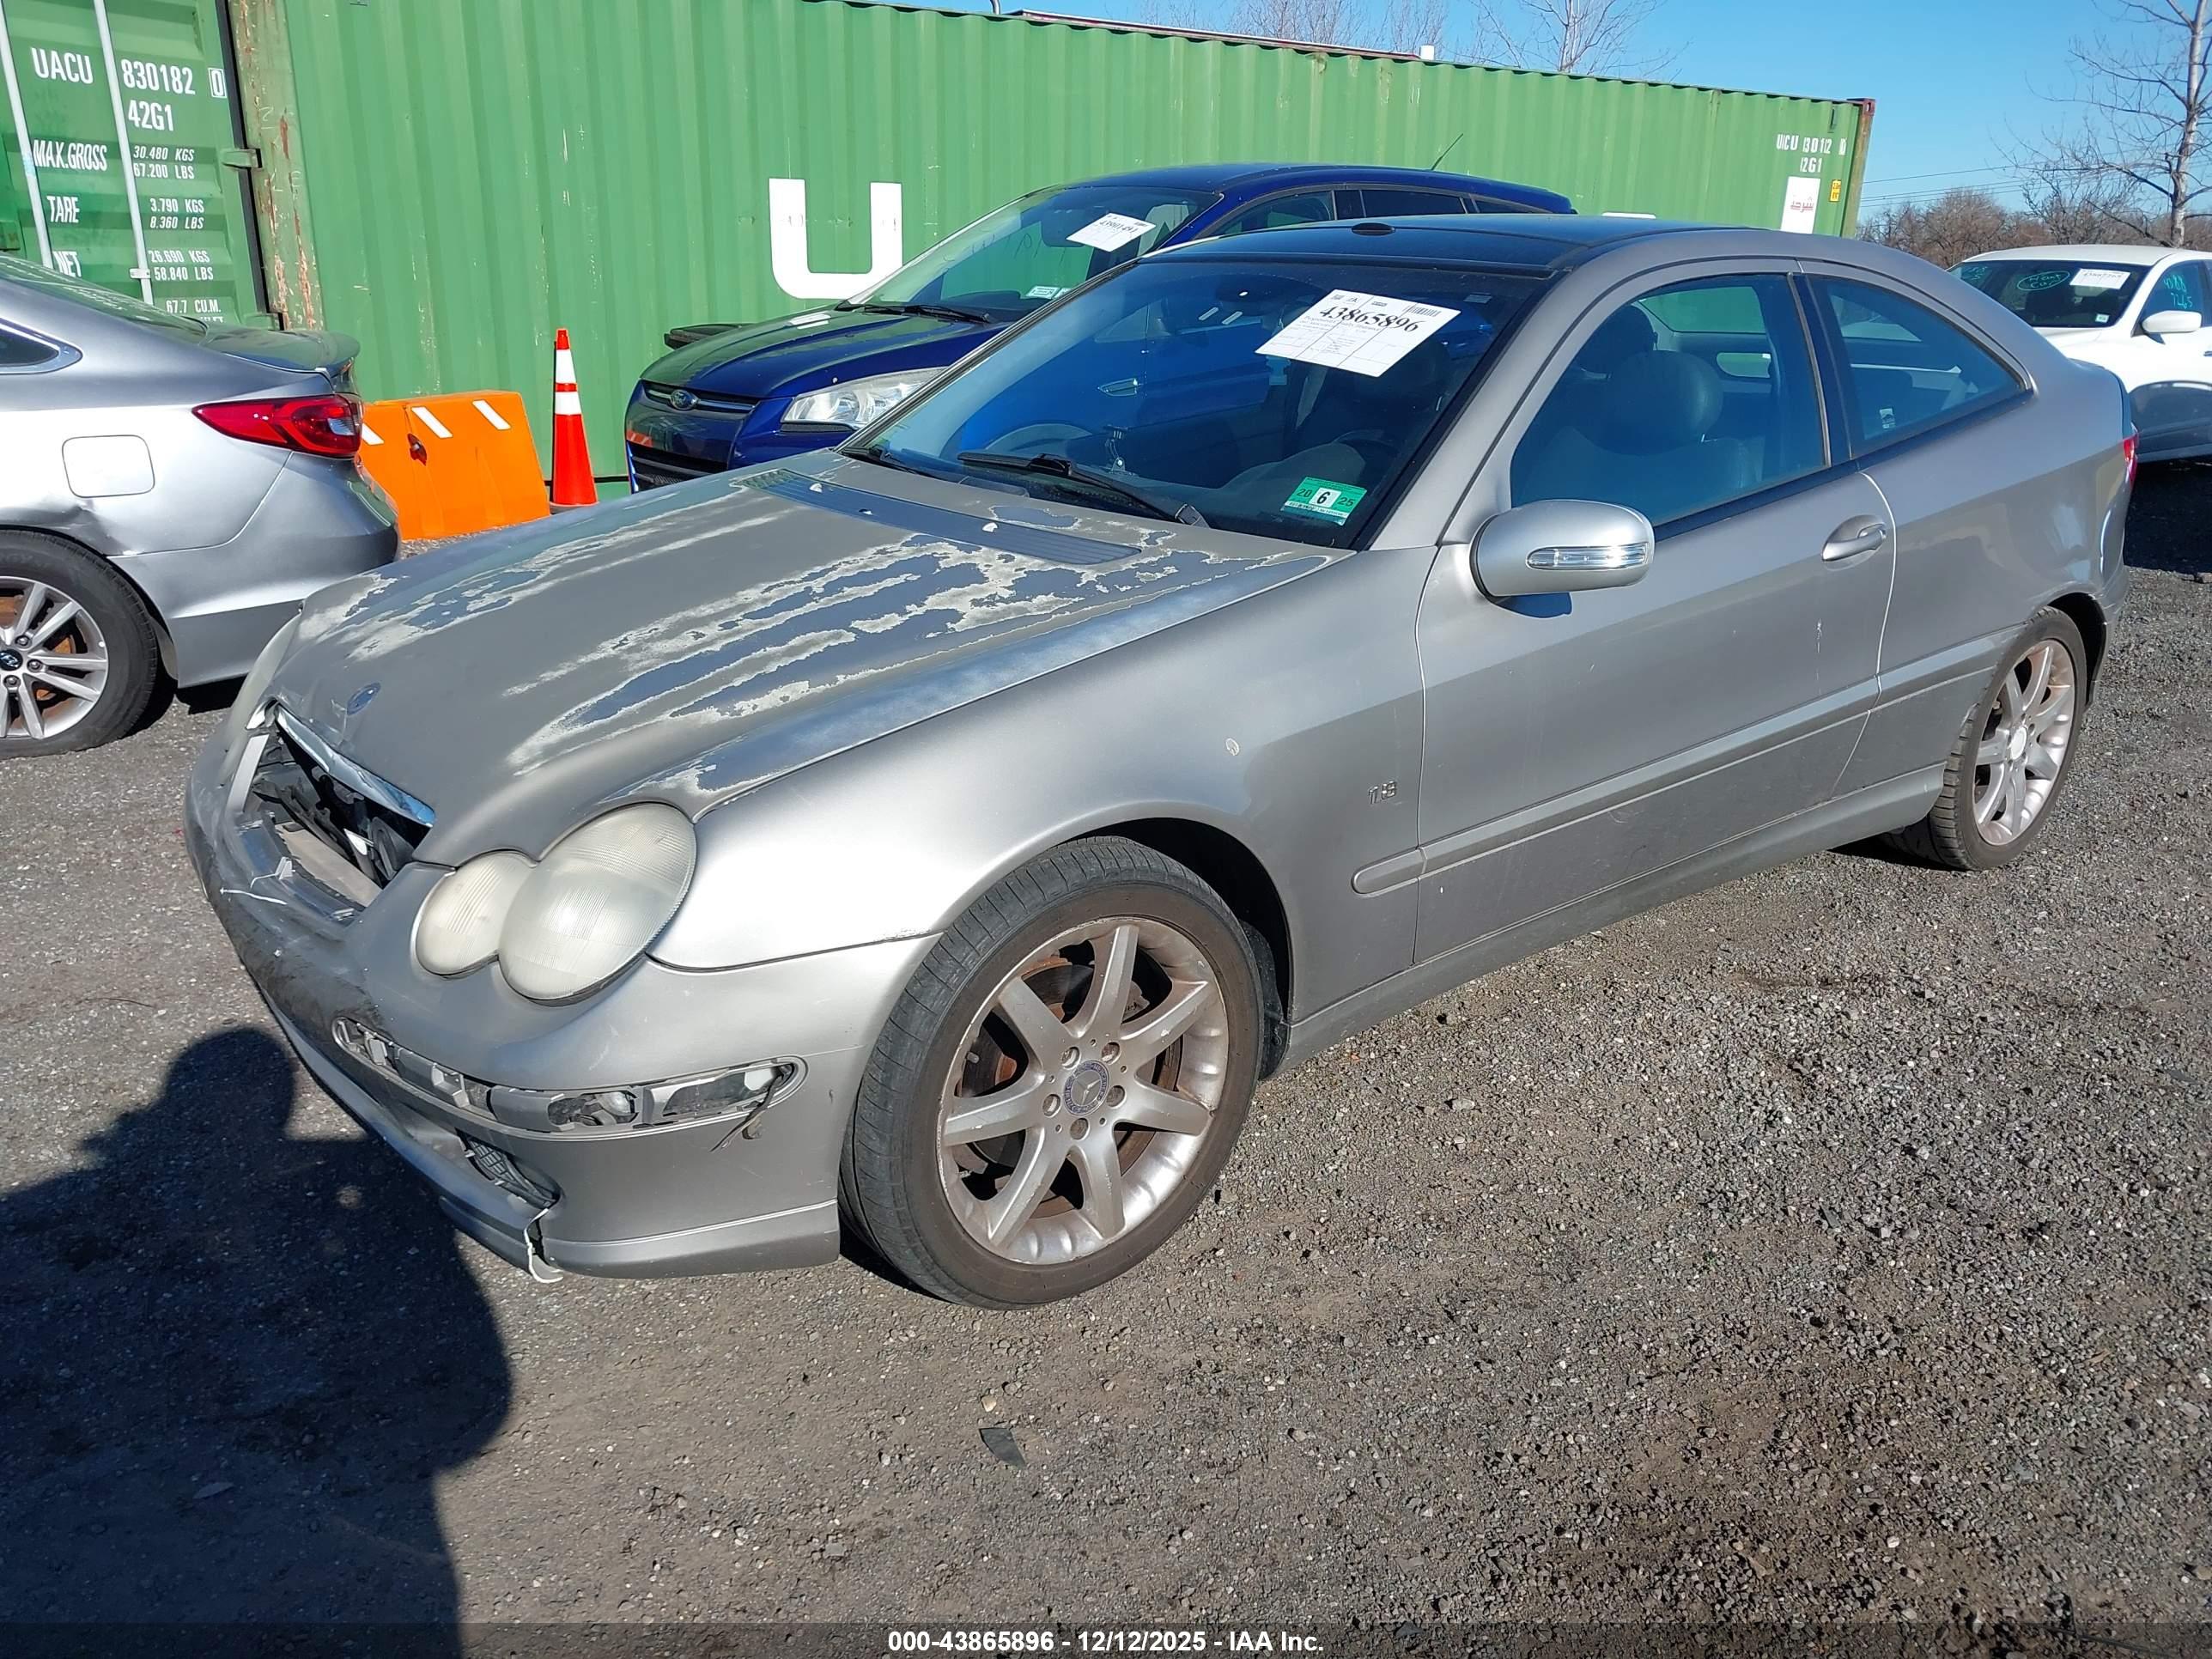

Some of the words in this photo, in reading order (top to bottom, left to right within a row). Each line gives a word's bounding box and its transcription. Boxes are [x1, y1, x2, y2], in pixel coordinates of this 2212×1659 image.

[31, 47, 94, 84] UACU
[121, 59, 196, 95] 830182
[211, 70, 225, 96] 0
[128, 100, 174, 131] 42G1
[133, 145, 168, 161] 30.480
[174, 149, 195, 161] KGS
[132, 163, 168, 179] 67.200
[174, 163, 195, 179] LBS
[46, 195, 79, 223] TARE
[149, 198, 179, 212] 3.790
[185, 198, 205, 214] KGS
[149, 216, 179, 229] 8.360
[185, 216, 204, 229] LBS
[769, 178, 902, 301] U
[53, 250, 82, 277] NET
[188, 250, 210, 263] KGS
[154, 266, 188, 281] 58.840
[194, 266, 214, 281] LBS
[166, 300, 187, 313] 67.7
[194, 299, 222, 313] CU.M.
[1319, 306, 1426, 333] 43865896
[1297, 488, 1313, 498] 20
[1316, 491, 1331, 505] 6
[1337, 496, 1354, 507] 25
